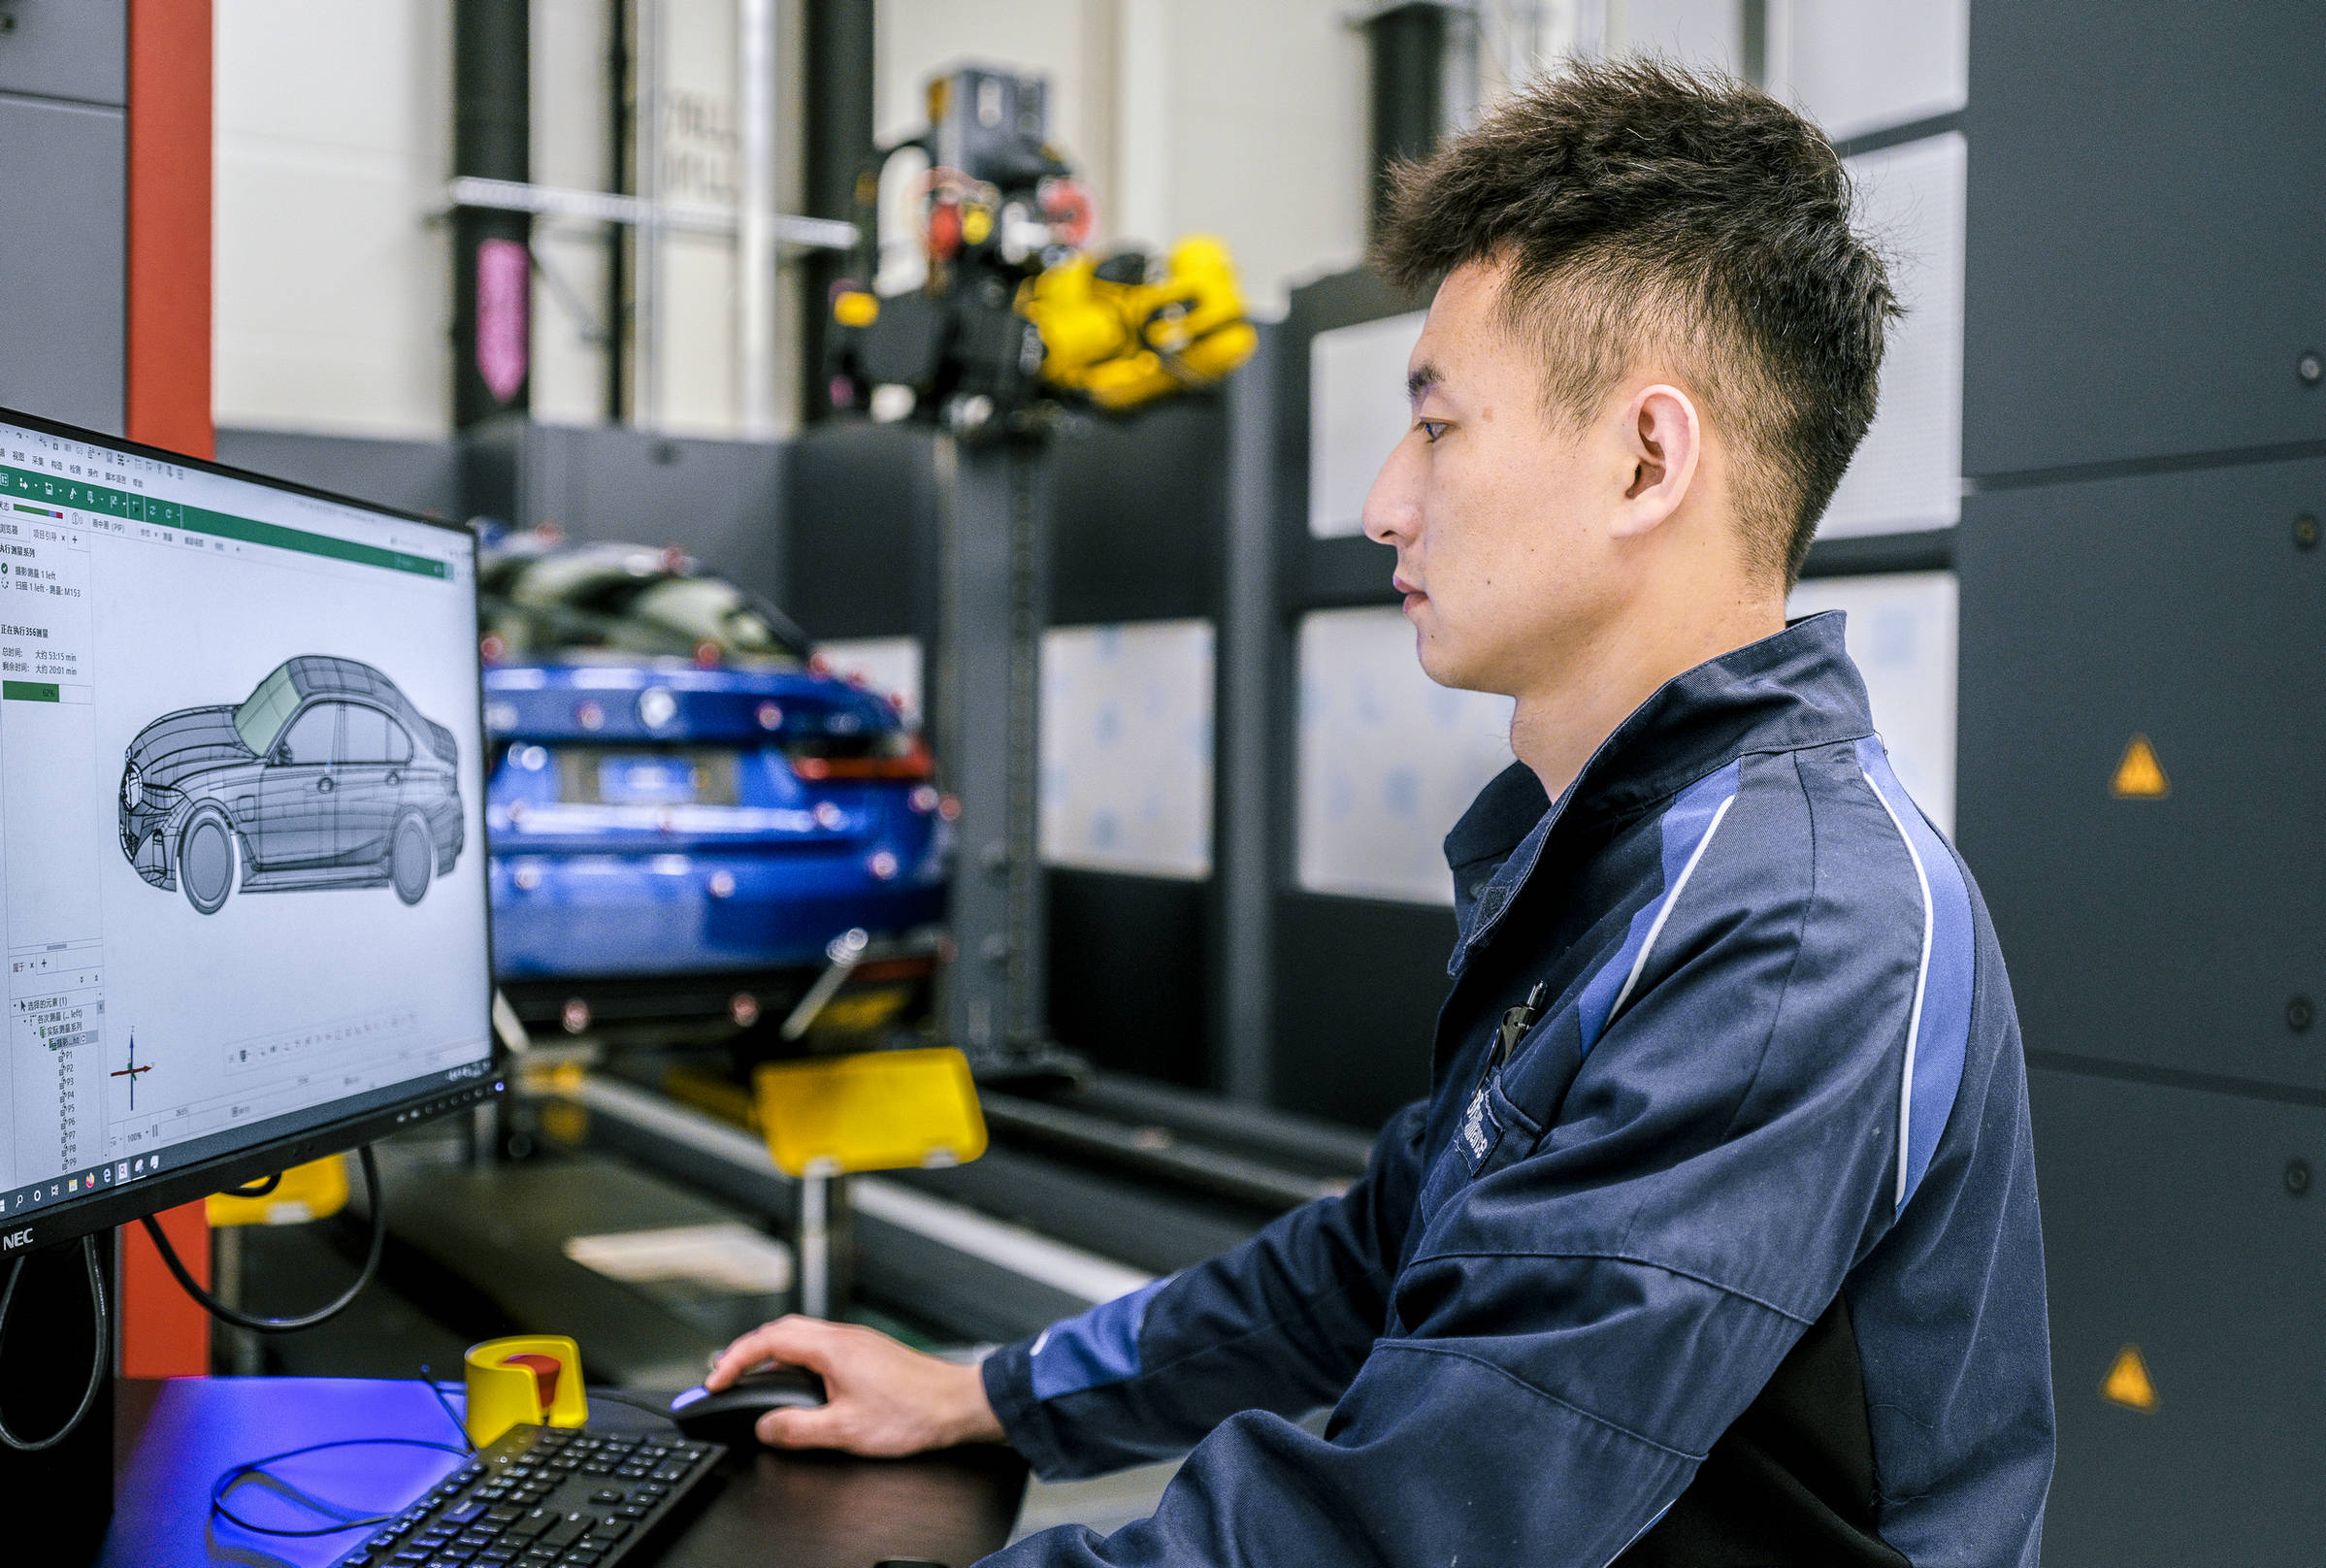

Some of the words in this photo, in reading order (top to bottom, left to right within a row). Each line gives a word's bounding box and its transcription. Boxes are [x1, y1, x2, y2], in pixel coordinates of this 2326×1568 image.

[64, 587, 82, 598] M153
[49, 650, 65, 662] 53:15
[65, 652, 77, 662] min
[49, 665, 64, 675] 20:01
[65, 666, 78, 676] min
[66, 1051, 73, 1060] P1
[66, 1063, 74, 1073] P2
[67, 1077, 74, 1086] P3
[67, 1091, 75, 1099] P4
[68, 1103, 75, 1113] P5
[68, 1117, 76, 1126] P6
[69, 1130, 76, 1139] P7
[69, 1144, 77, 1153] P8
[70, 1158, 77, 1166] P9
[3, 1227, 34, 1251] NEC
